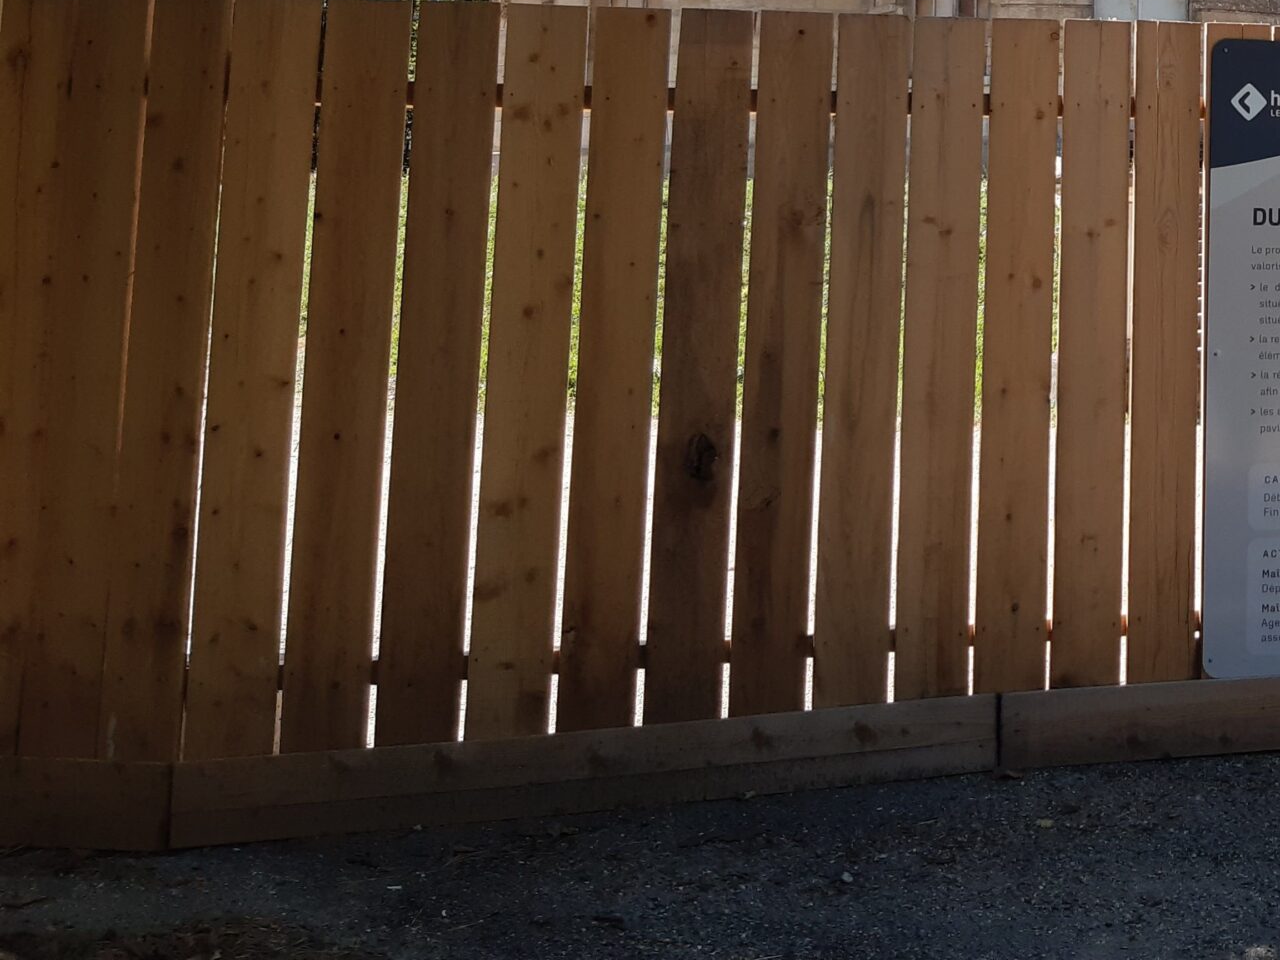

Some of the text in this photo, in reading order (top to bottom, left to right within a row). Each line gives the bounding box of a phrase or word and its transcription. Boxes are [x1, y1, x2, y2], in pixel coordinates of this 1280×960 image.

[1270, 108, 1280, 117] LE
[1252, 246, 1262, 254] Le
[1260, 283, 1268, 291] le
[1259, 335, 1268, 343] la
[1261, 371, 1269, 379] la
[1260, 388, 1278, 396] afin
[1260, 408, 1274, 416] les
[1264, 508, 1279, 516] Fin
